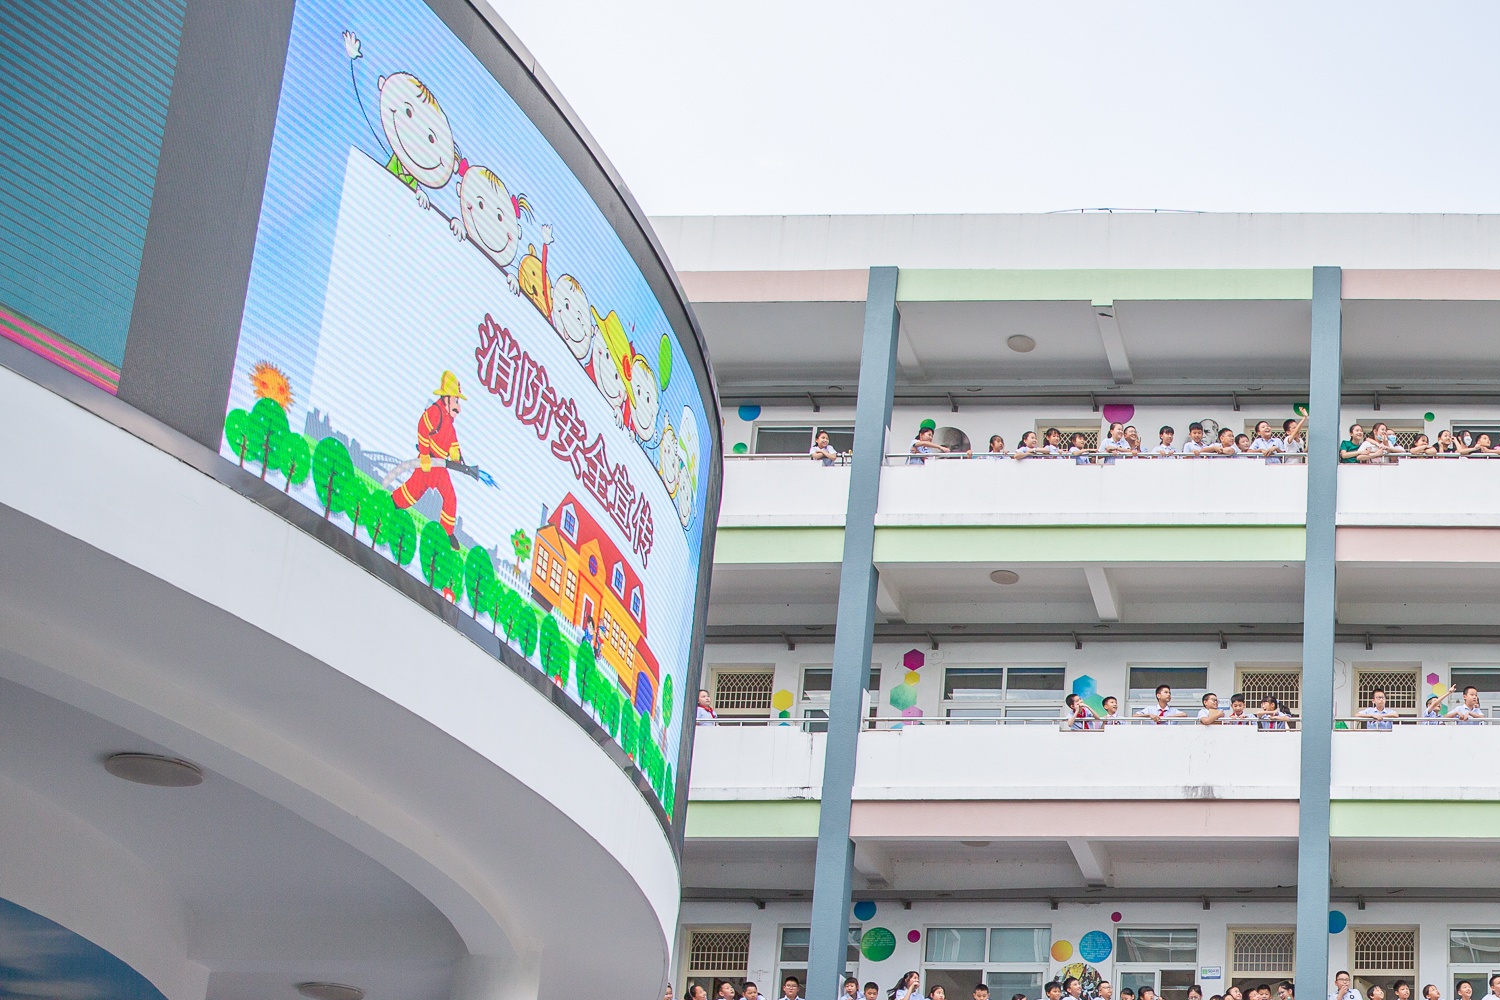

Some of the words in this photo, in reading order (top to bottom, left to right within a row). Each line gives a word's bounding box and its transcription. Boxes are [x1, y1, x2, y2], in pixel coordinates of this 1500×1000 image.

[475, 313, 653, 569] 消防安全宣传
